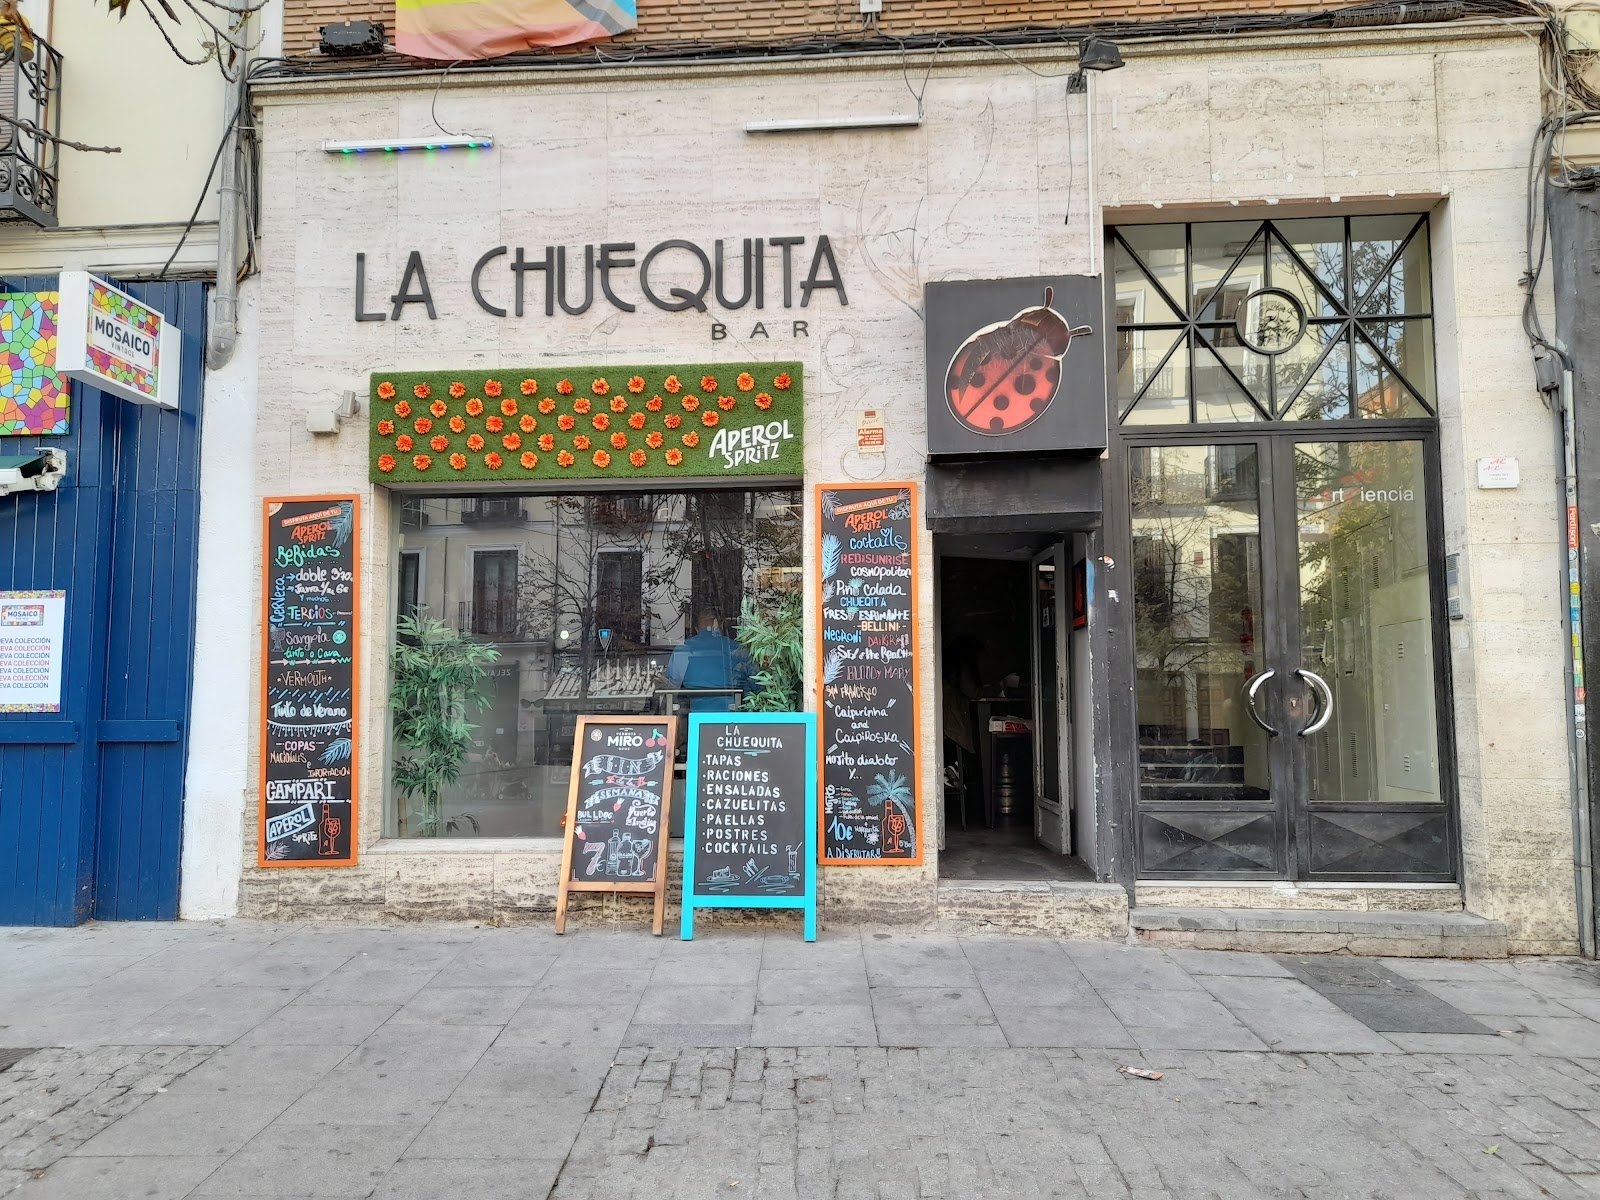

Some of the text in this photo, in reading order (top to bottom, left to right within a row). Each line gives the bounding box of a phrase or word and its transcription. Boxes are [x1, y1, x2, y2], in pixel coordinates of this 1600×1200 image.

[354, 235, 849, 321] LA CHUEQUITA
[95, 315, 150, 356] MOSAICO
[711, 320, 809, 340] BAR
[709, 420, 793, 458] APEROL
[845, 510, 888, 528] APEROL
[291, 521, 333, 540] APEROL
[841, 554, 908, 565] RED SUNRISE
[295, 566, 327, 582] doble
[863, 582, 906, 596] Colada
[861, 621, 899, 631] BELLINI
[281, 669, 327, 686] VERMOUTH
[300, 704, 312, 716] de
[313, 703, 347, 717] Verano
[726, 725, 740, 735] LA
[851, 720, 869, 729] and
[285, 741, 316, 751] COPAS
[717, 737, 783, 748] CHUEQUITA
[706, 755, 742, 766] TAPAS
[707, 770, 769, 782] RACIONES
[600, 789, 643, 799] SEMANA
[707, 784, 780, 798] ENSALADAS
[707, 799, 786, 812] CAZUELITAS
[577, 810, 613, 819] BULLDOG
[707, 814, 765, 826] PAELLAS
[270, 807, 310, 837] APEROL
[706, 829, 768, 841] POSTRES
[705, 842, 778, 855] COCKTAILS
